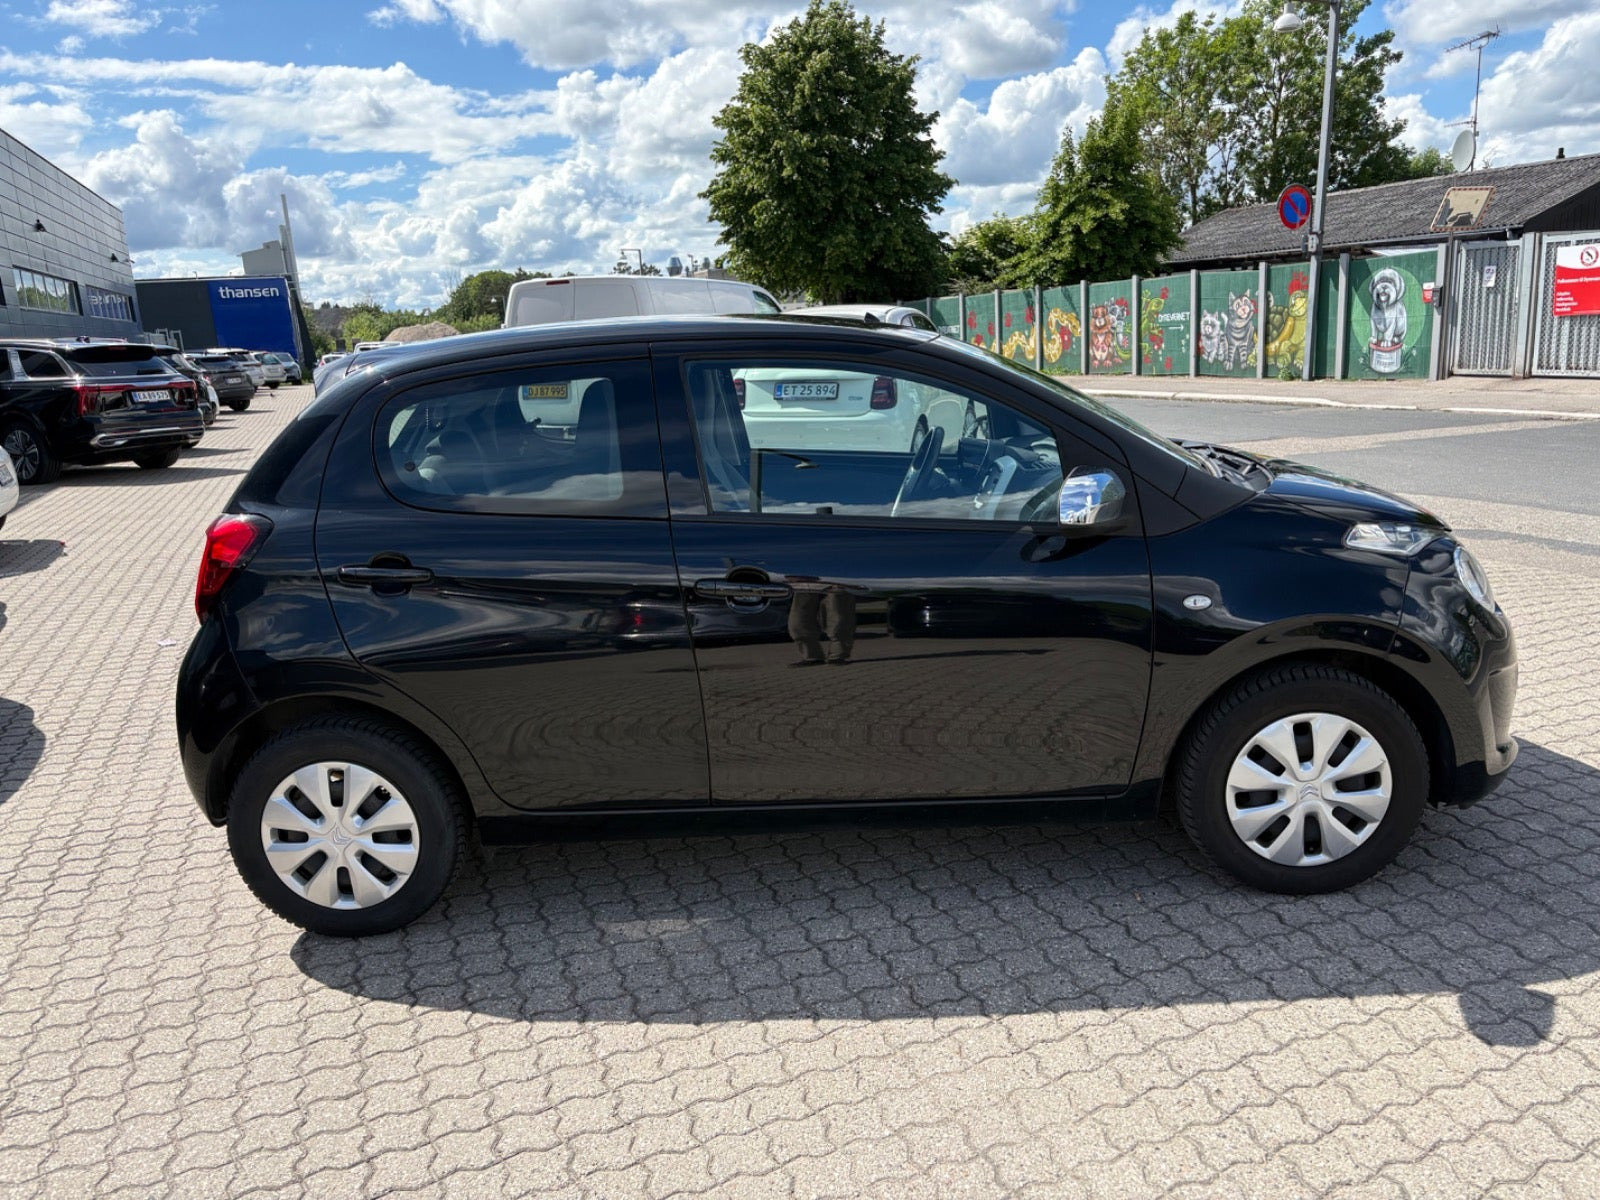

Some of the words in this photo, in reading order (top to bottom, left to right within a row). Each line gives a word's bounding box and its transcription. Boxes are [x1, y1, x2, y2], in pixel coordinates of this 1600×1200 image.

[218, 286, 280, 299] thansen
[783, 385, 798, 396] ET
[800, 385, 813, 396] 25
[815, 385, 836, 396] 894
